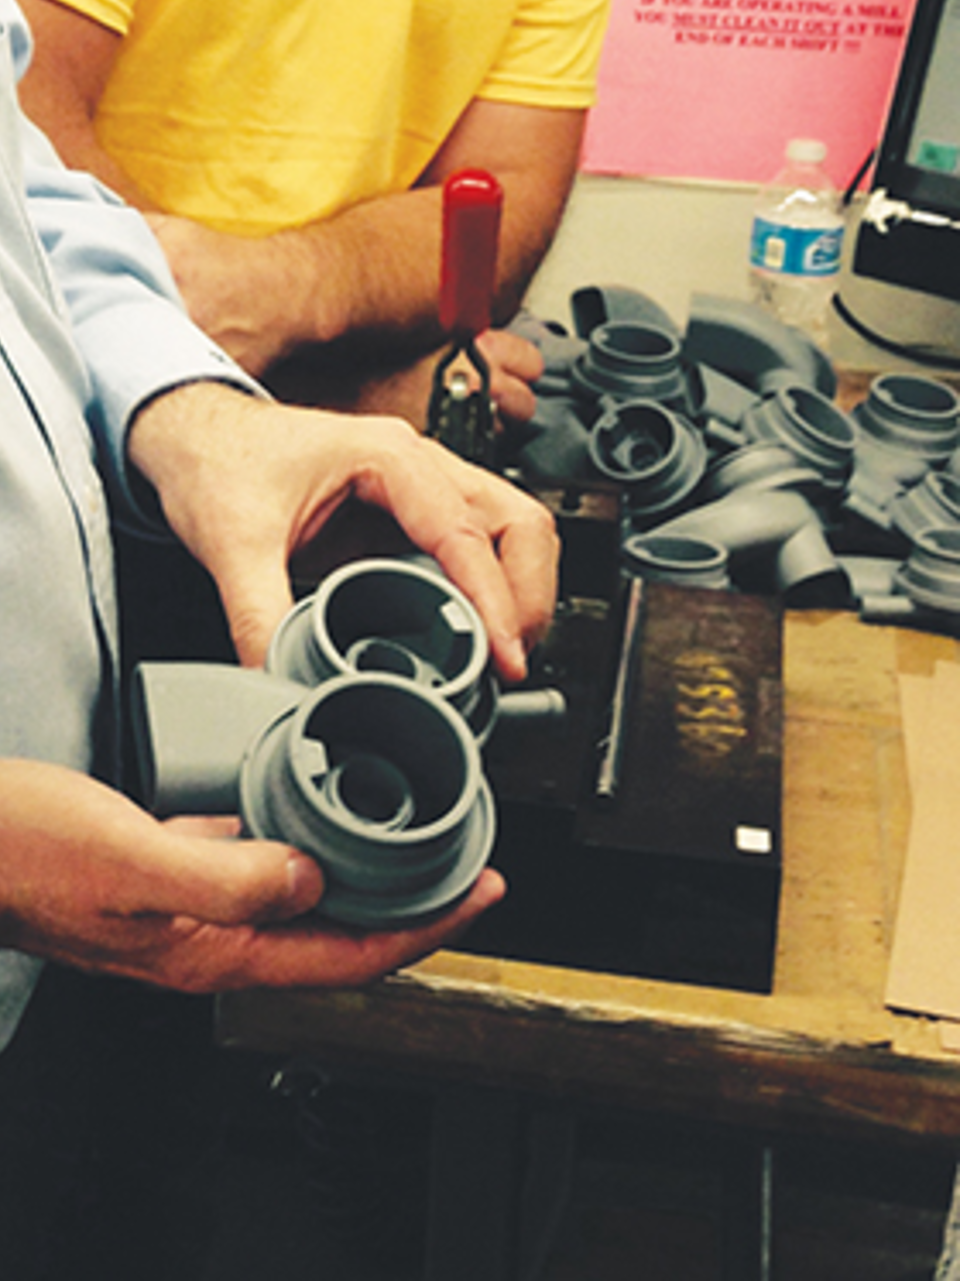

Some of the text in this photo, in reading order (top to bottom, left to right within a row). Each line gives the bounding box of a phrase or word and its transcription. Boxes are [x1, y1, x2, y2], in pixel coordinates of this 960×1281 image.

[843, 3, 853, 17] A
[634, 9, 667, 24] YOU
[673, 11, 718, 29] MUST
[722, 14, 779, 32] CLEAN
[846, 21, 867, 36] AT
[674, 31, 709, 45] END
[712, 33, 734, 45] OF
[739, 35, 786, 50] EACH
